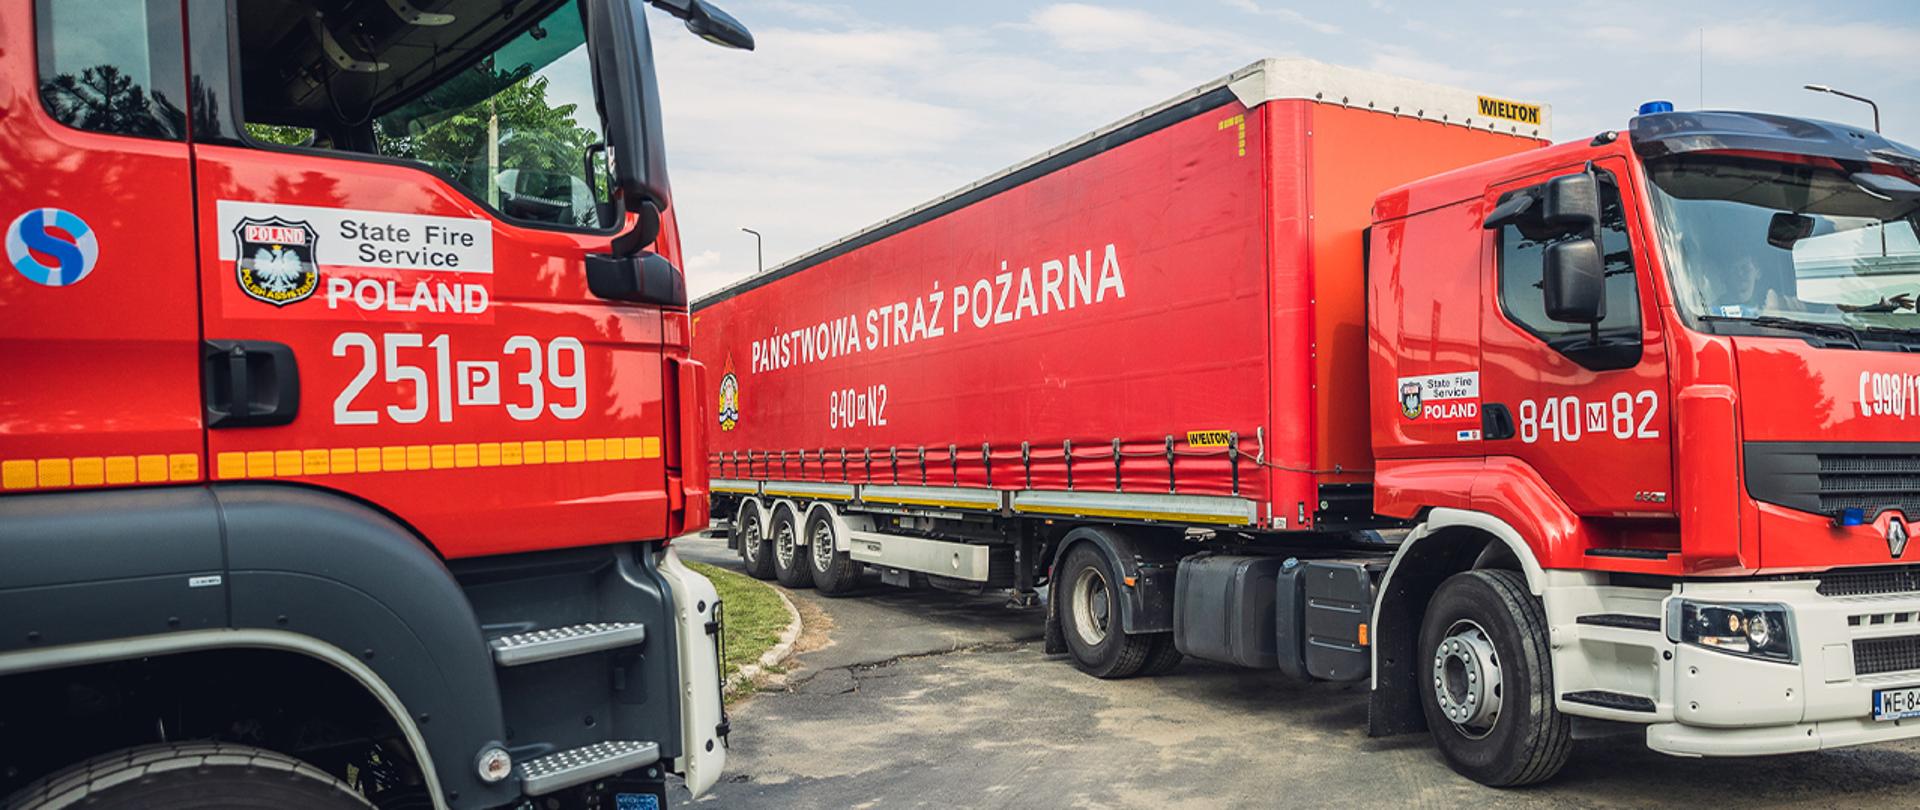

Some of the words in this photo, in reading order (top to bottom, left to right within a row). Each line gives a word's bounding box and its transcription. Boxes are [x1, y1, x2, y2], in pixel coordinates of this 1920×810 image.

[1479, 98, 1538, 124] WIELTON
[249, 225, 304, 244] POLAND
[340, 219, 411, 243] State
[425, 226, 474, 248] Fire
[358, 243, 459, 268] Service
[326, 277, 490, 315] POLAND
[752, 314, 861, 374] PAŃSTWOWA
[865, 280, 945, 351] STRAŻ
[952, 243, 1127, 334] POŻARNA
[332, 331, 453, 426] 251
[466, 364, 492, 402] P
[502, 335, 588, 421] 39
[1427, 378, 1451, 389] State
[1455, 376, 1473, 387] Fire
[1433, 387, 1467, 398] Service
[830, 388, 856, 430] 840
[867, 383, 888, 427] N2
[1424, 402, 1478, 420] POLAND
[1519, 395, 1581, 443] 840
[1587, 404, 1606, 431] M
[1611, 390, 1660, 440] 82
[1189, 431, 1230, 445] WIELTON
